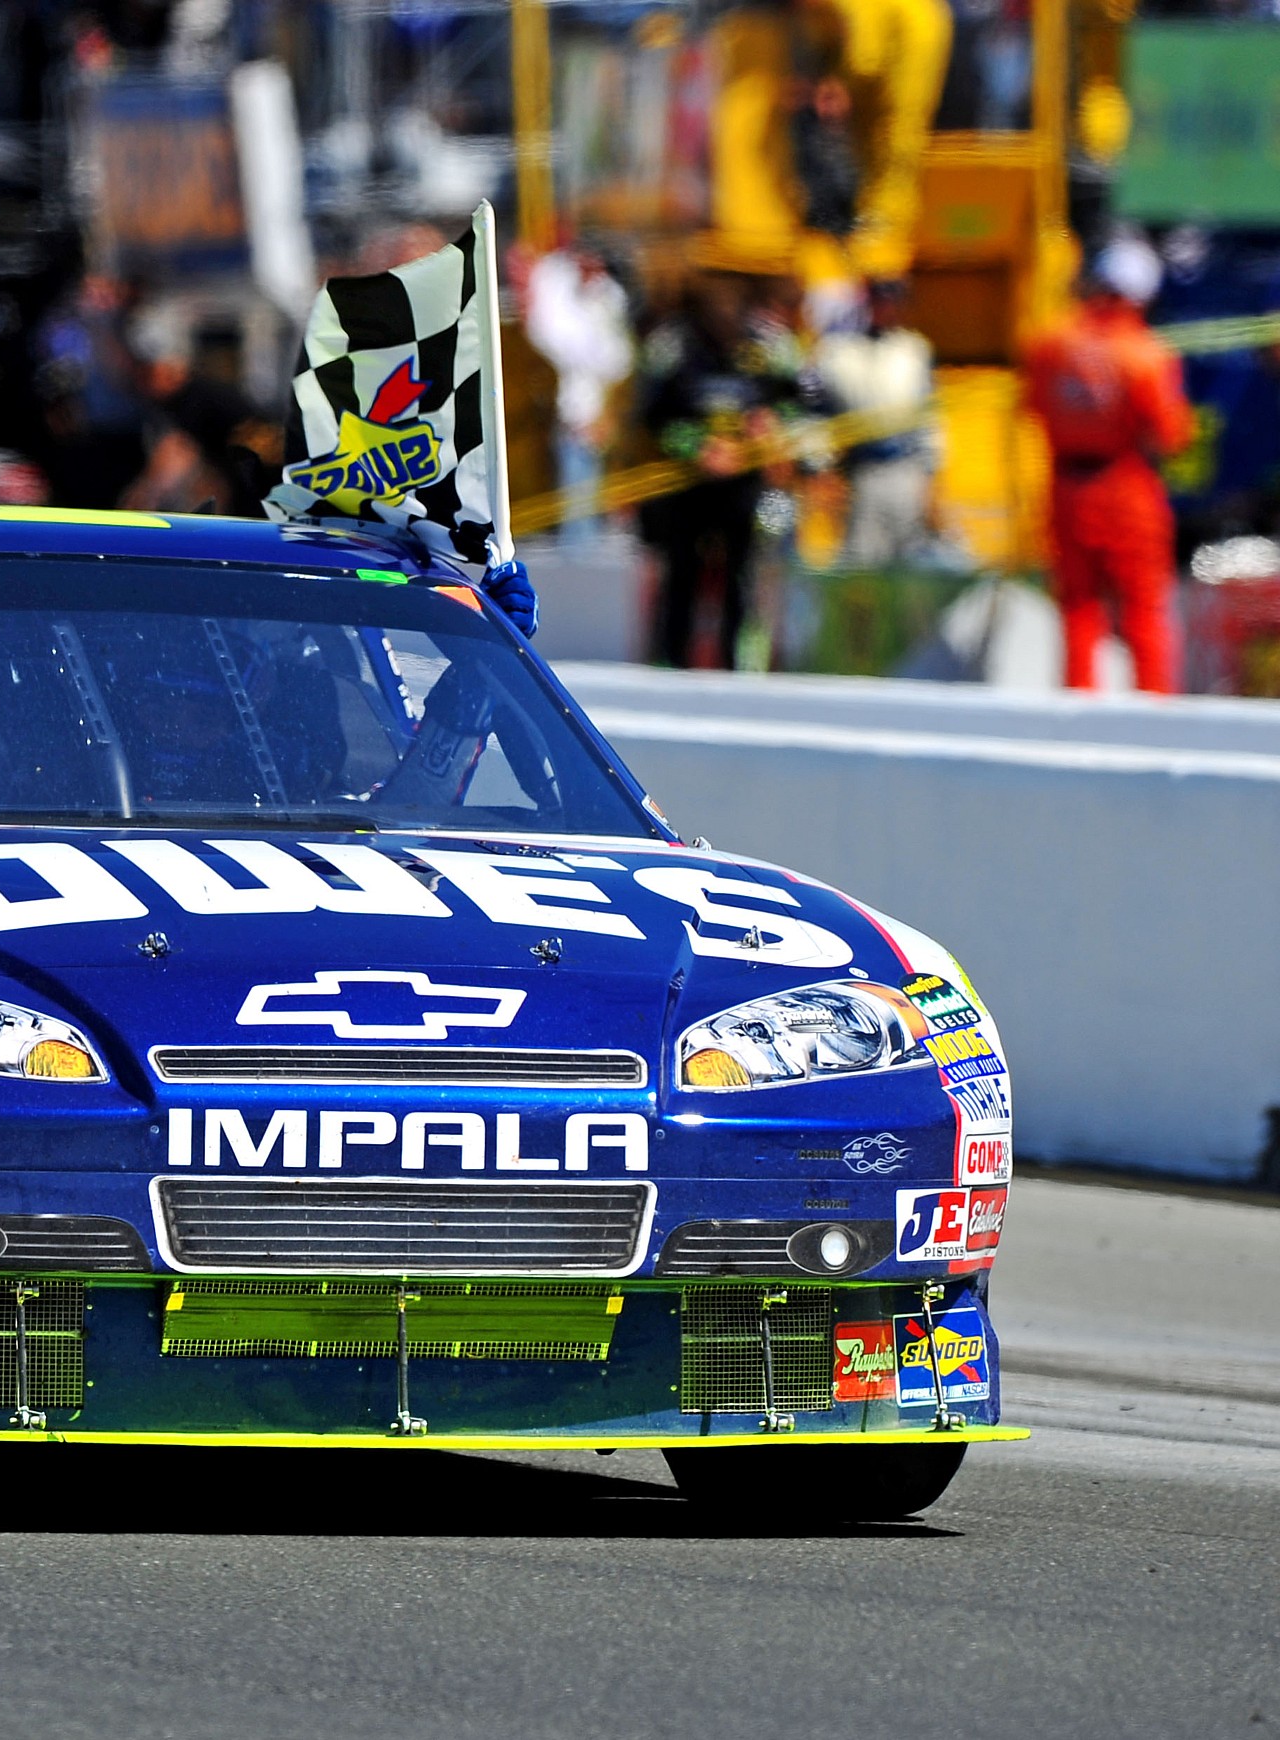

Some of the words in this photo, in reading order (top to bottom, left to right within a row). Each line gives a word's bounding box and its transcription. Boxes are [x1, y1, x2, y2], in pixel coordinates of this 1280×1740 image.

[934, 1010, 980, 1030] BELTS
[923, 1027, 993, 1068] MOOG
[168, 1108, 649, 1171] IMPALA
[967, 1140, 1003, 1174] COMP
[899, 1191, 966, 1256] JE
[924, 1246, 964, 1257] PISTONS
